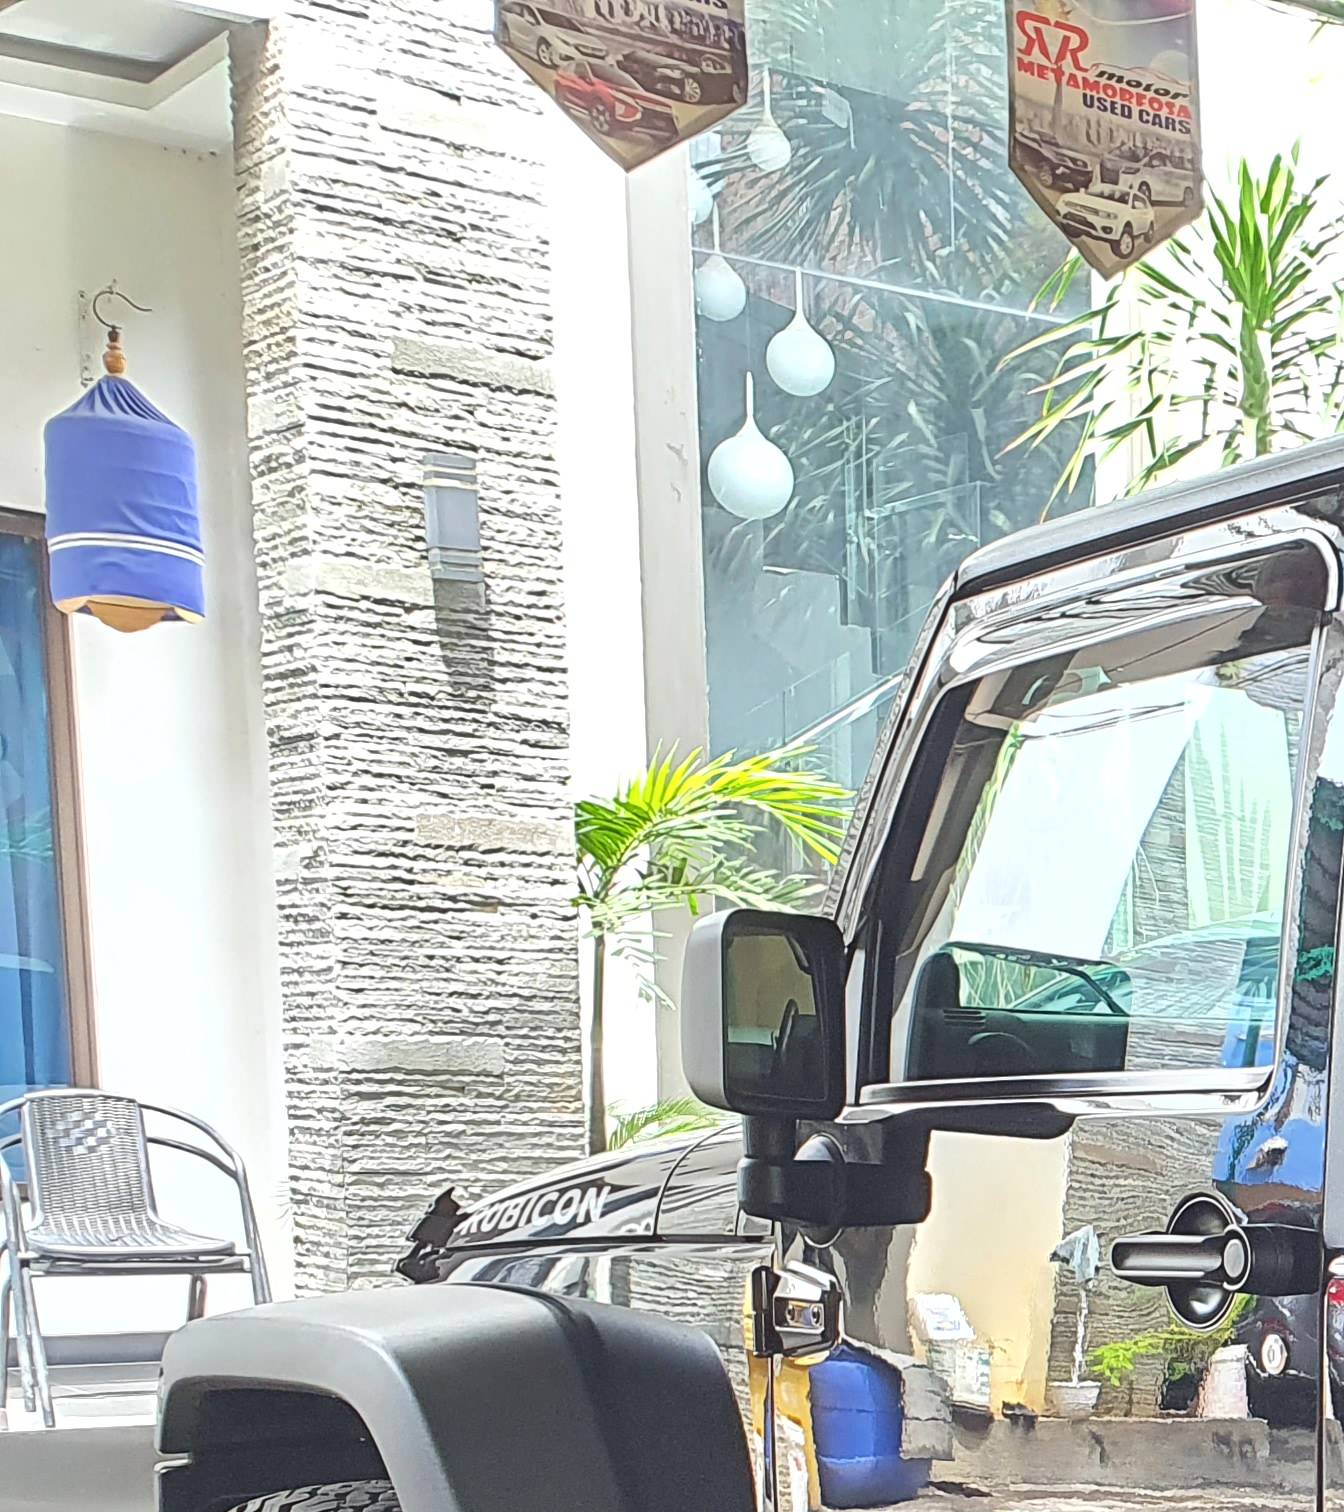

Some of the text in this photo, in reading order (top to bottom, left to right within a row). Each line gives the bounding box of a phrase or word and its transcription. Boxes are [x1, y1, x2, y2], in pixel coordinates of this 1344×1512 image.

[1095, 70, 1190, 100] motor
[1082, 92, 1191, 135] USED CARS
[454, 1185, 612, 1236] RUBICON
